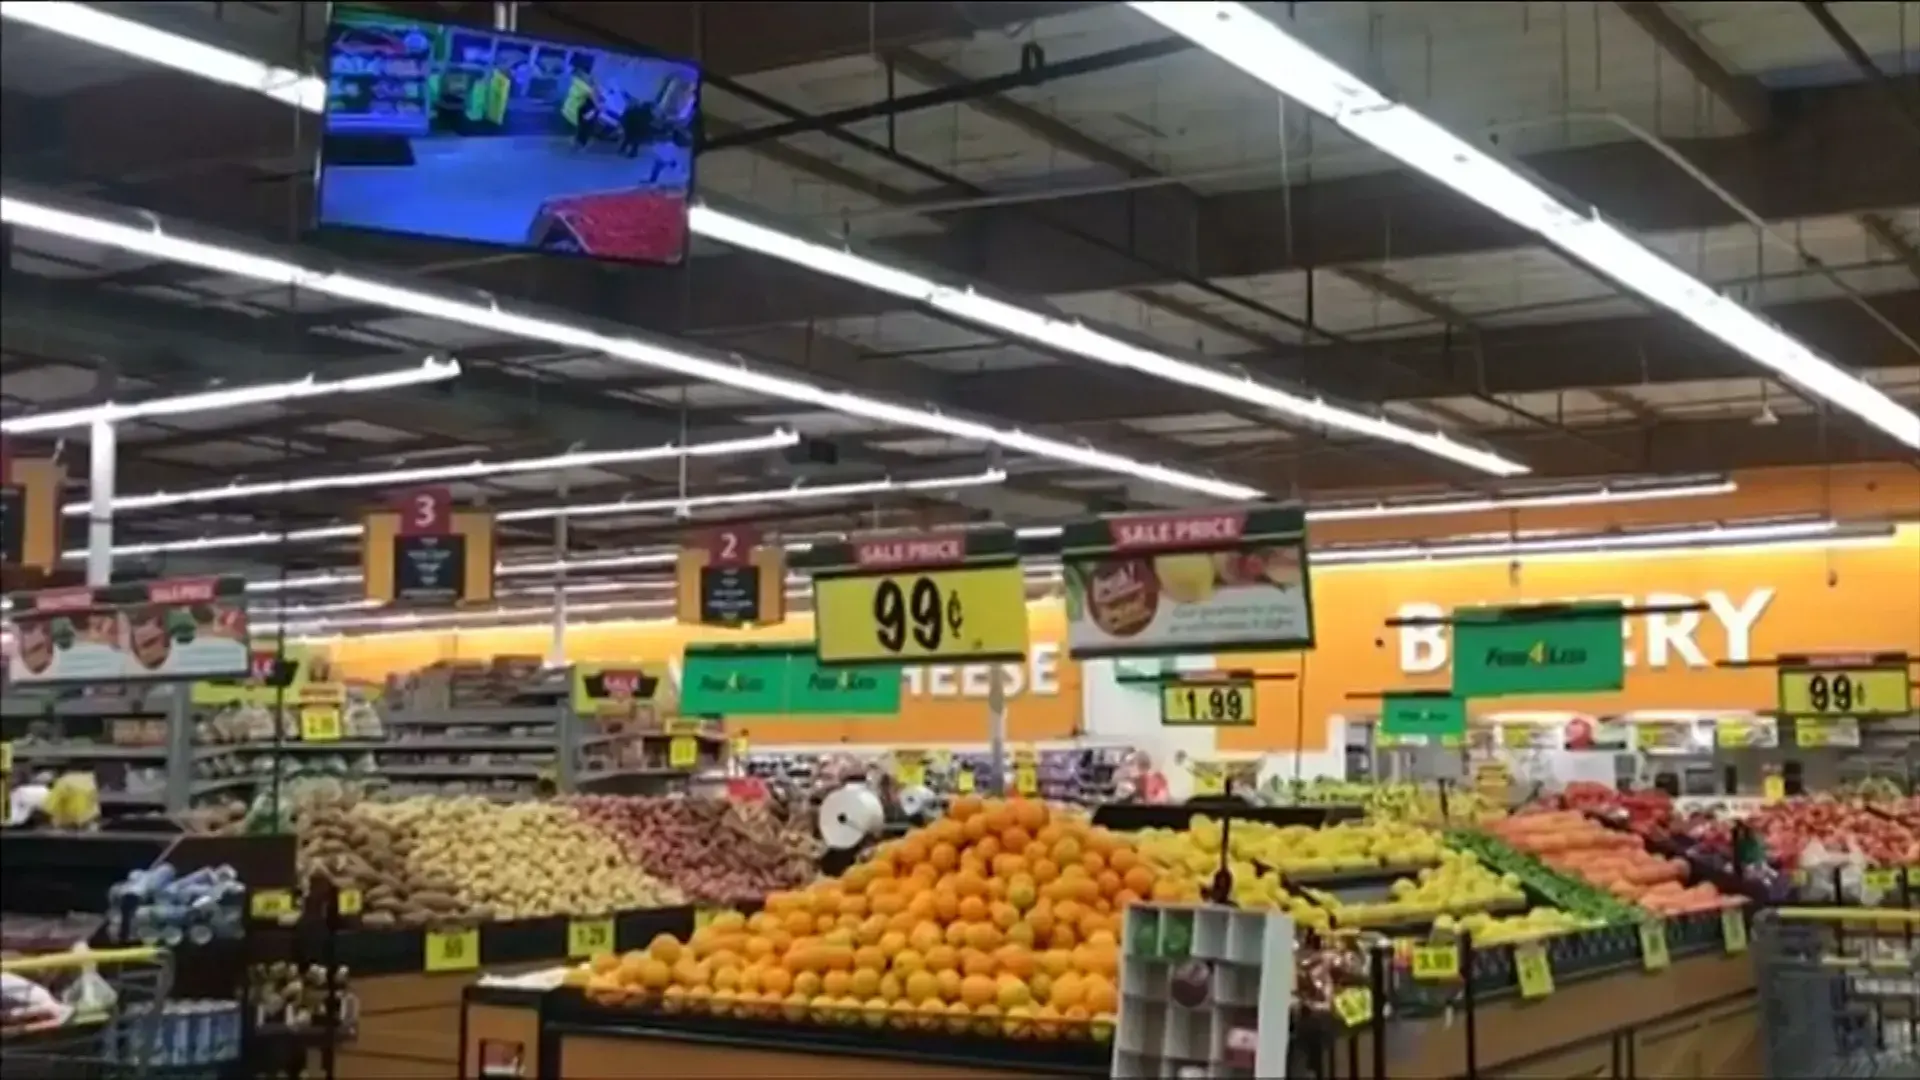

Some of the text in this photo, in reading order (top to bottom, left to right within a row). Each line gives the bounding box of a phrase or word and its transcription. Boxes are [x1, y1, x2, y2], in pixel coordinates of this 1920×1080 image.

[415, 494, 436, 528] 3
[1119, 518, 1236, 544] SALE PRICE
[721, 532, 738, 558] 2
[860, 540, 959, 564] SALE PRICE
[874, 576, 963, 653] 99¢
